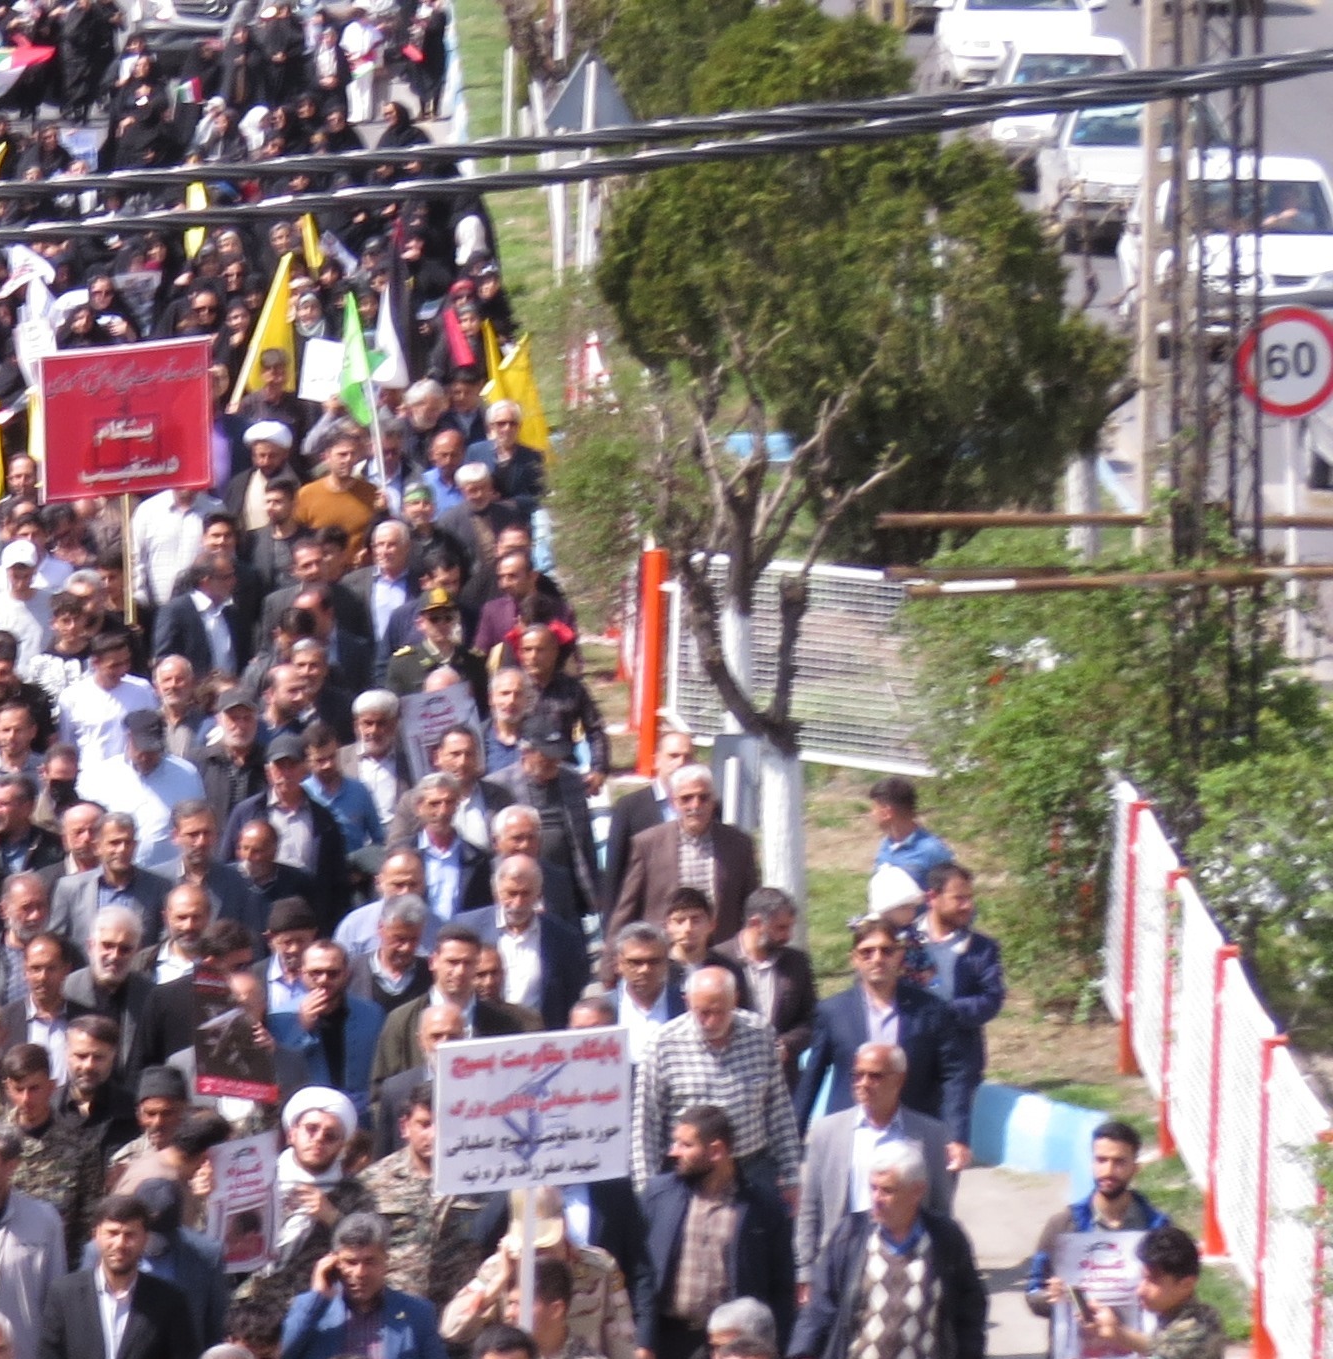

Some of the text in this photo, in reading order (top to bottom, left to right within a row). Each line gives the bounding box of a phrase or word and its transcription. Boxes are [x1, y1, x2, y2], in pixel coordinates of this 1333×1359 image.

[1266, 341, 1316, 380] 60
[451, 1036, 621, 1080] پایگاه مقاومت بسیج
[589, 1084, 621, 1107] شهید
[445, 1133, 496, 1157] عملیاتی
[587, 1126, 621, 1144] حوزه
[569, 1154, 601, 1175] شهید
